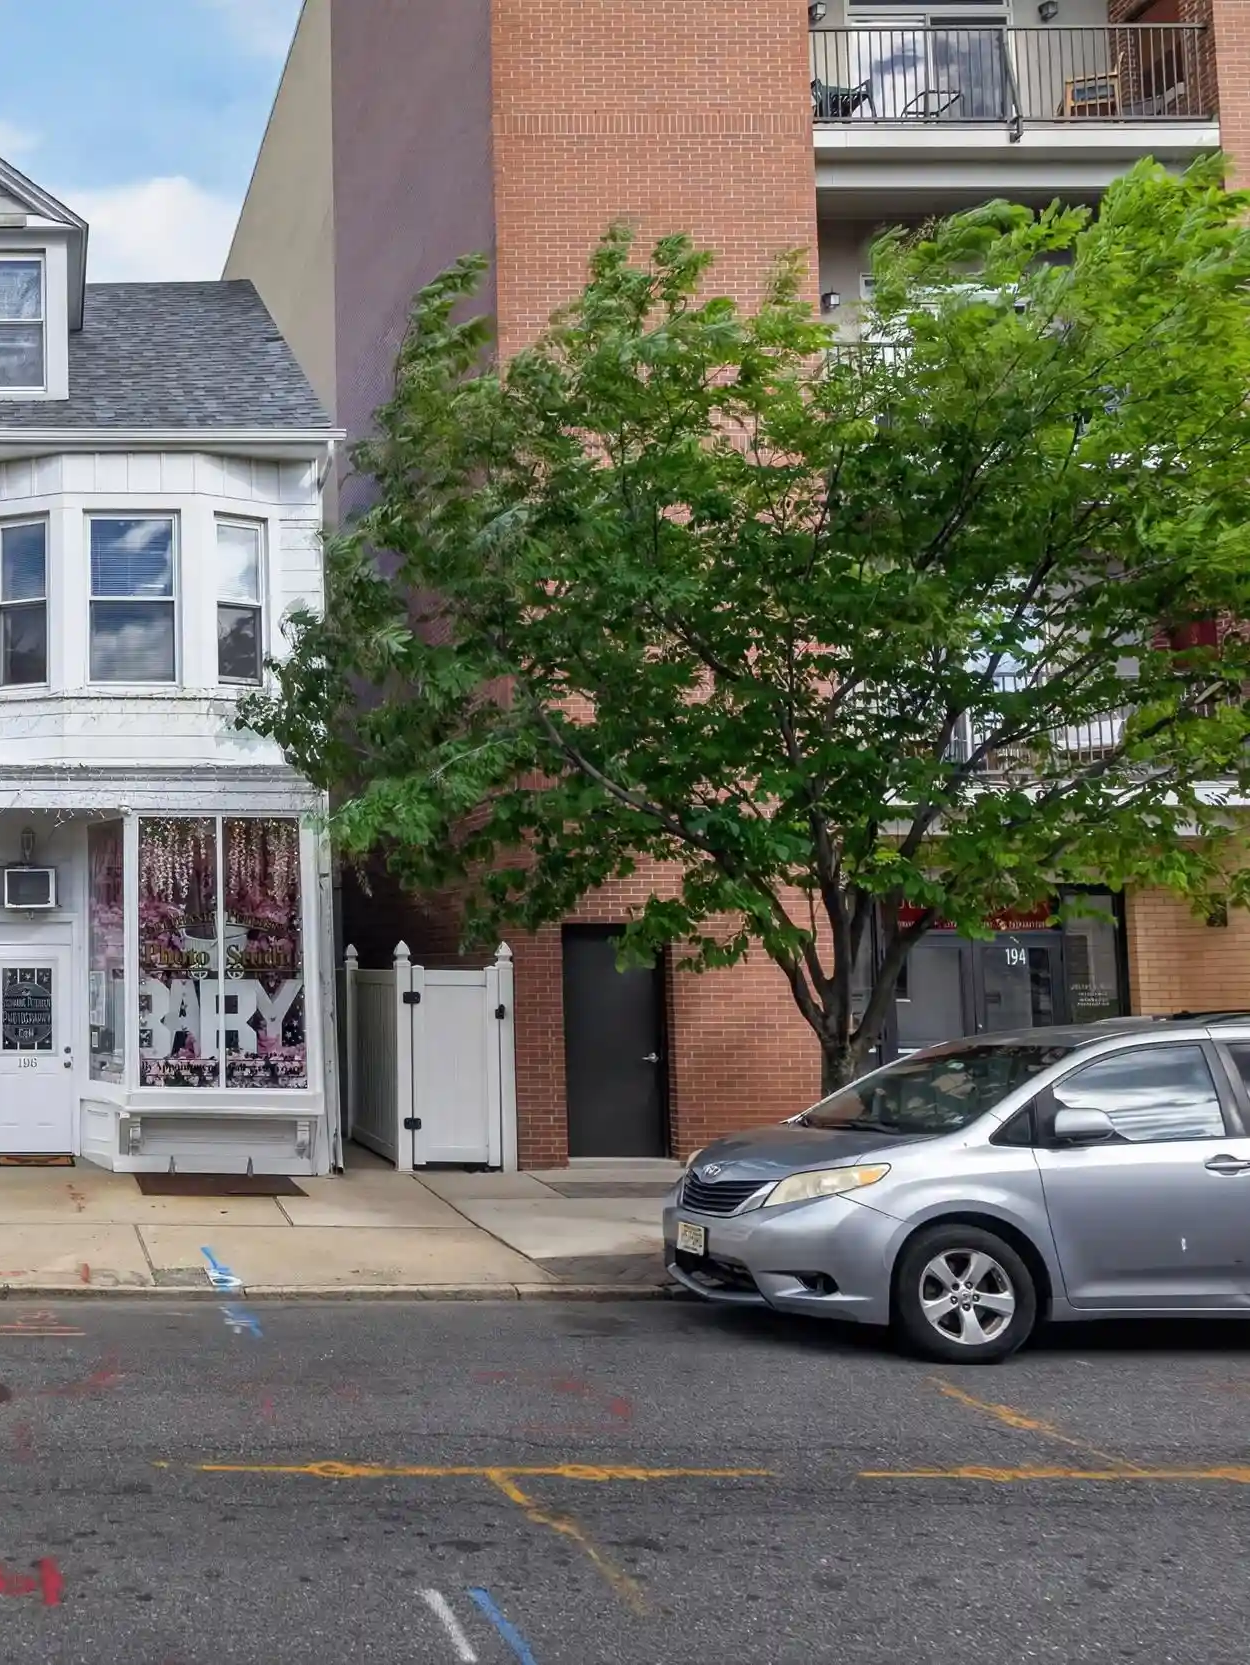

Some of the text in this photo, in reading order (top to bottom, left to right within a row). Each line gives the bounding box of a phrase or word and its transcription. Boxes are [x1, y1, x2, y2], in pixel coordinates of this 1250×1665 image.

[144, 943, 211, 966] Photo
[1005, 947, 1026, 966] 194
[139, 978, 305, 1059] BABY
[17, 1057, 38, 1068] 196
